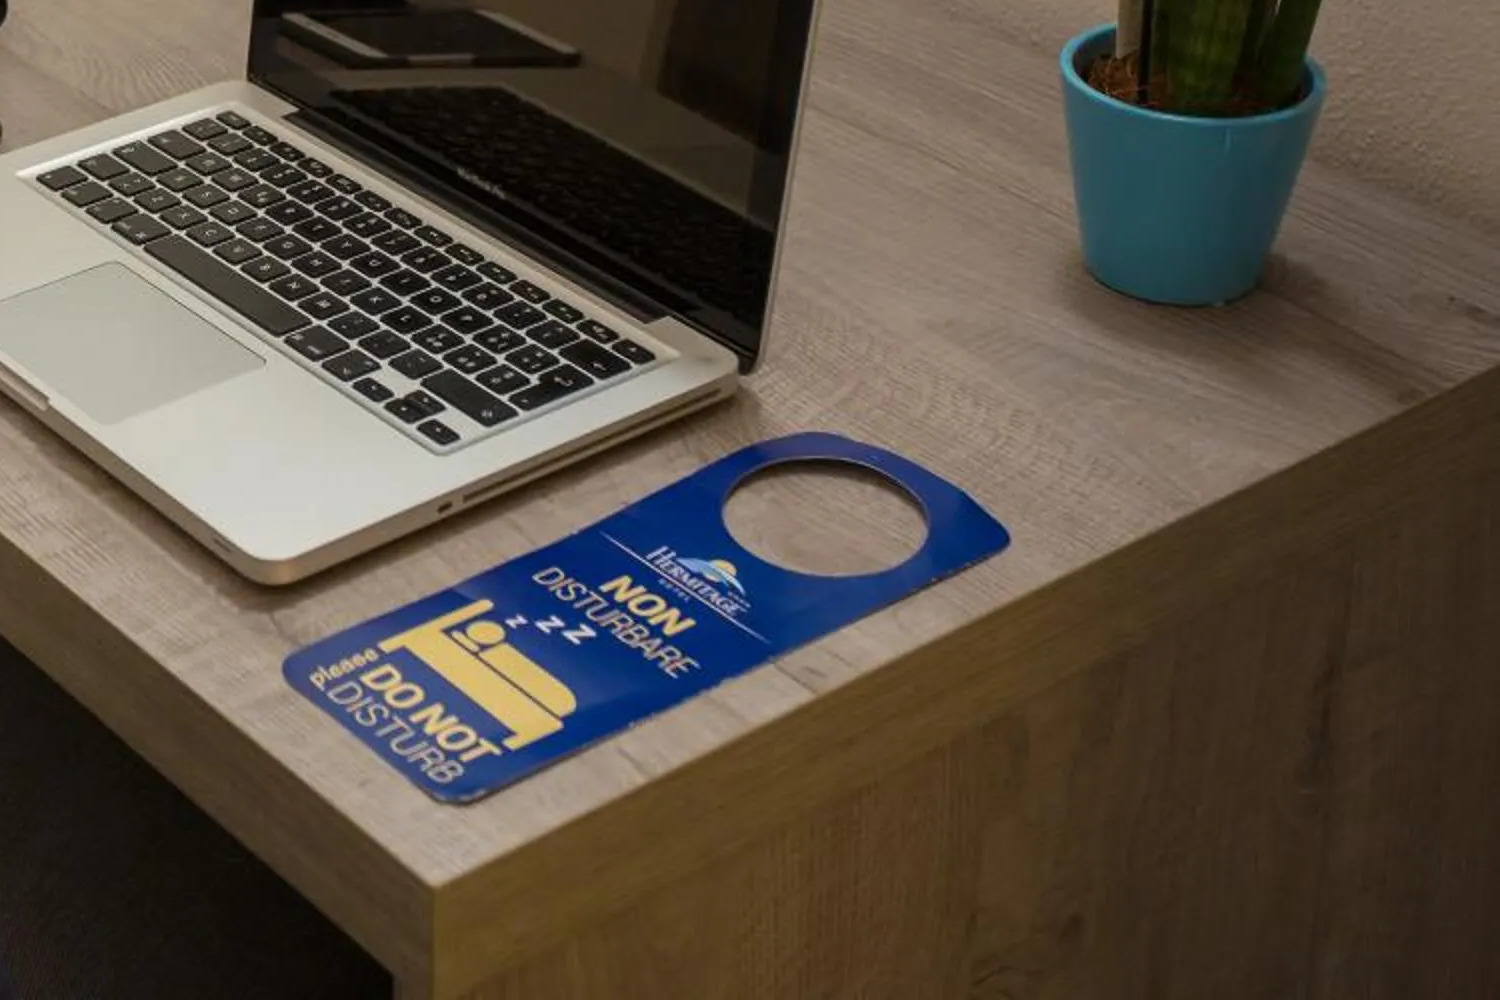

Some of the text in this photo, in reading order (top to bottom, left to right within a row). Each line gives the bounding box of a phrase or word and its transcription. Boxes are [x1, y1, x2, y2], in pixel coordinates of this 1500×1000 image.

[532, 567, 701, 680] DISTURBARE
[599, 575, 696, 637] NON
[645, 546, 748, 617] HERMITAGE
[308, 647, 380, 692] please
[326, 680, 465, 785] DISTURB
[359, 663, 503, 762] DO NOT
